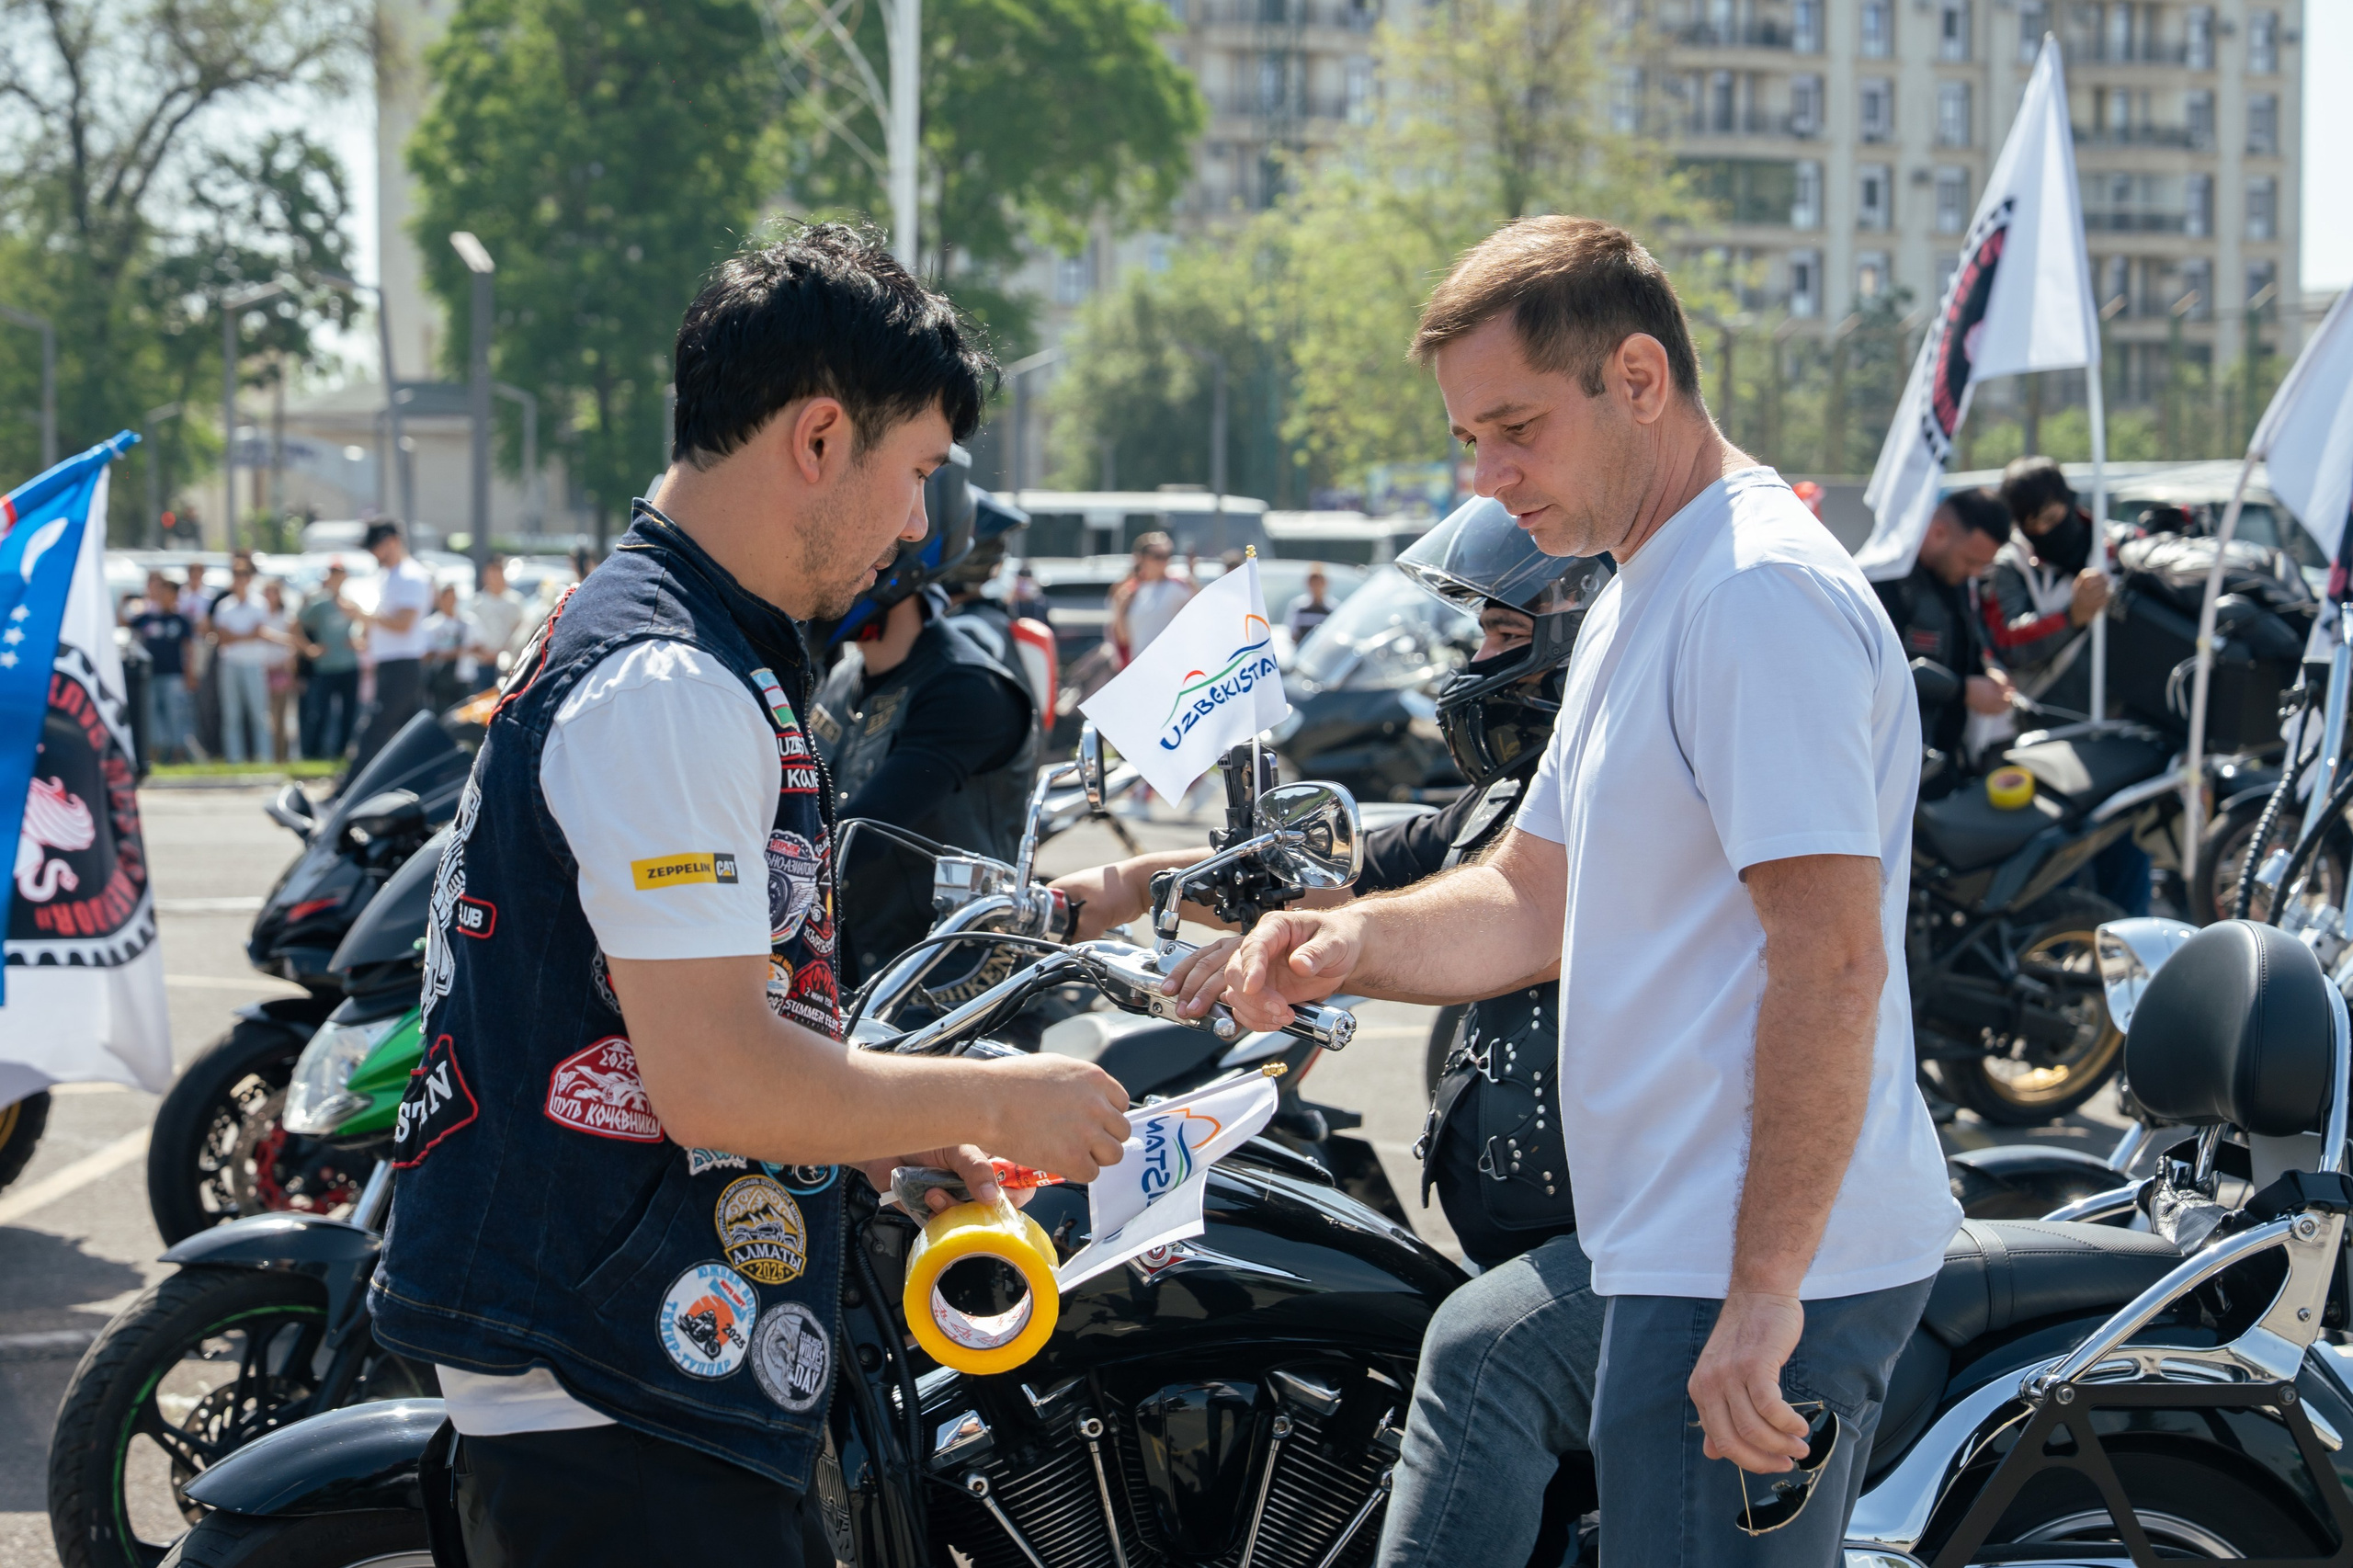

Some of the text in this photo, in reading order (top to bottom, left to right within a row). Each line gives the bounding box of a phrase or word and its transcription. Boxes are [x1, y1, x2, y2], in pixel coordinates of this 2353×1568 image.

[646, 859, 736, 880] ZEPPELIN CAT
[458, 902, 483, 929] LUB
[782, 998, 825, 1023] SUMMER
[824, 1015, 839, 1031] FEST
[599, 1049, 635, 1072] 2025
[553, 1096, 658, 1134] ПУТЬ КОЧЕВНИКА
[733, 1243, 802, 1271] АЛМАТЫ
[756, 1262, 784, 1280] 2025
[722, 1323, 746, 1350] 2025
[798, 1341, 824, 1367] WOLVES
[793, 1363, 821, 1394] DAY
